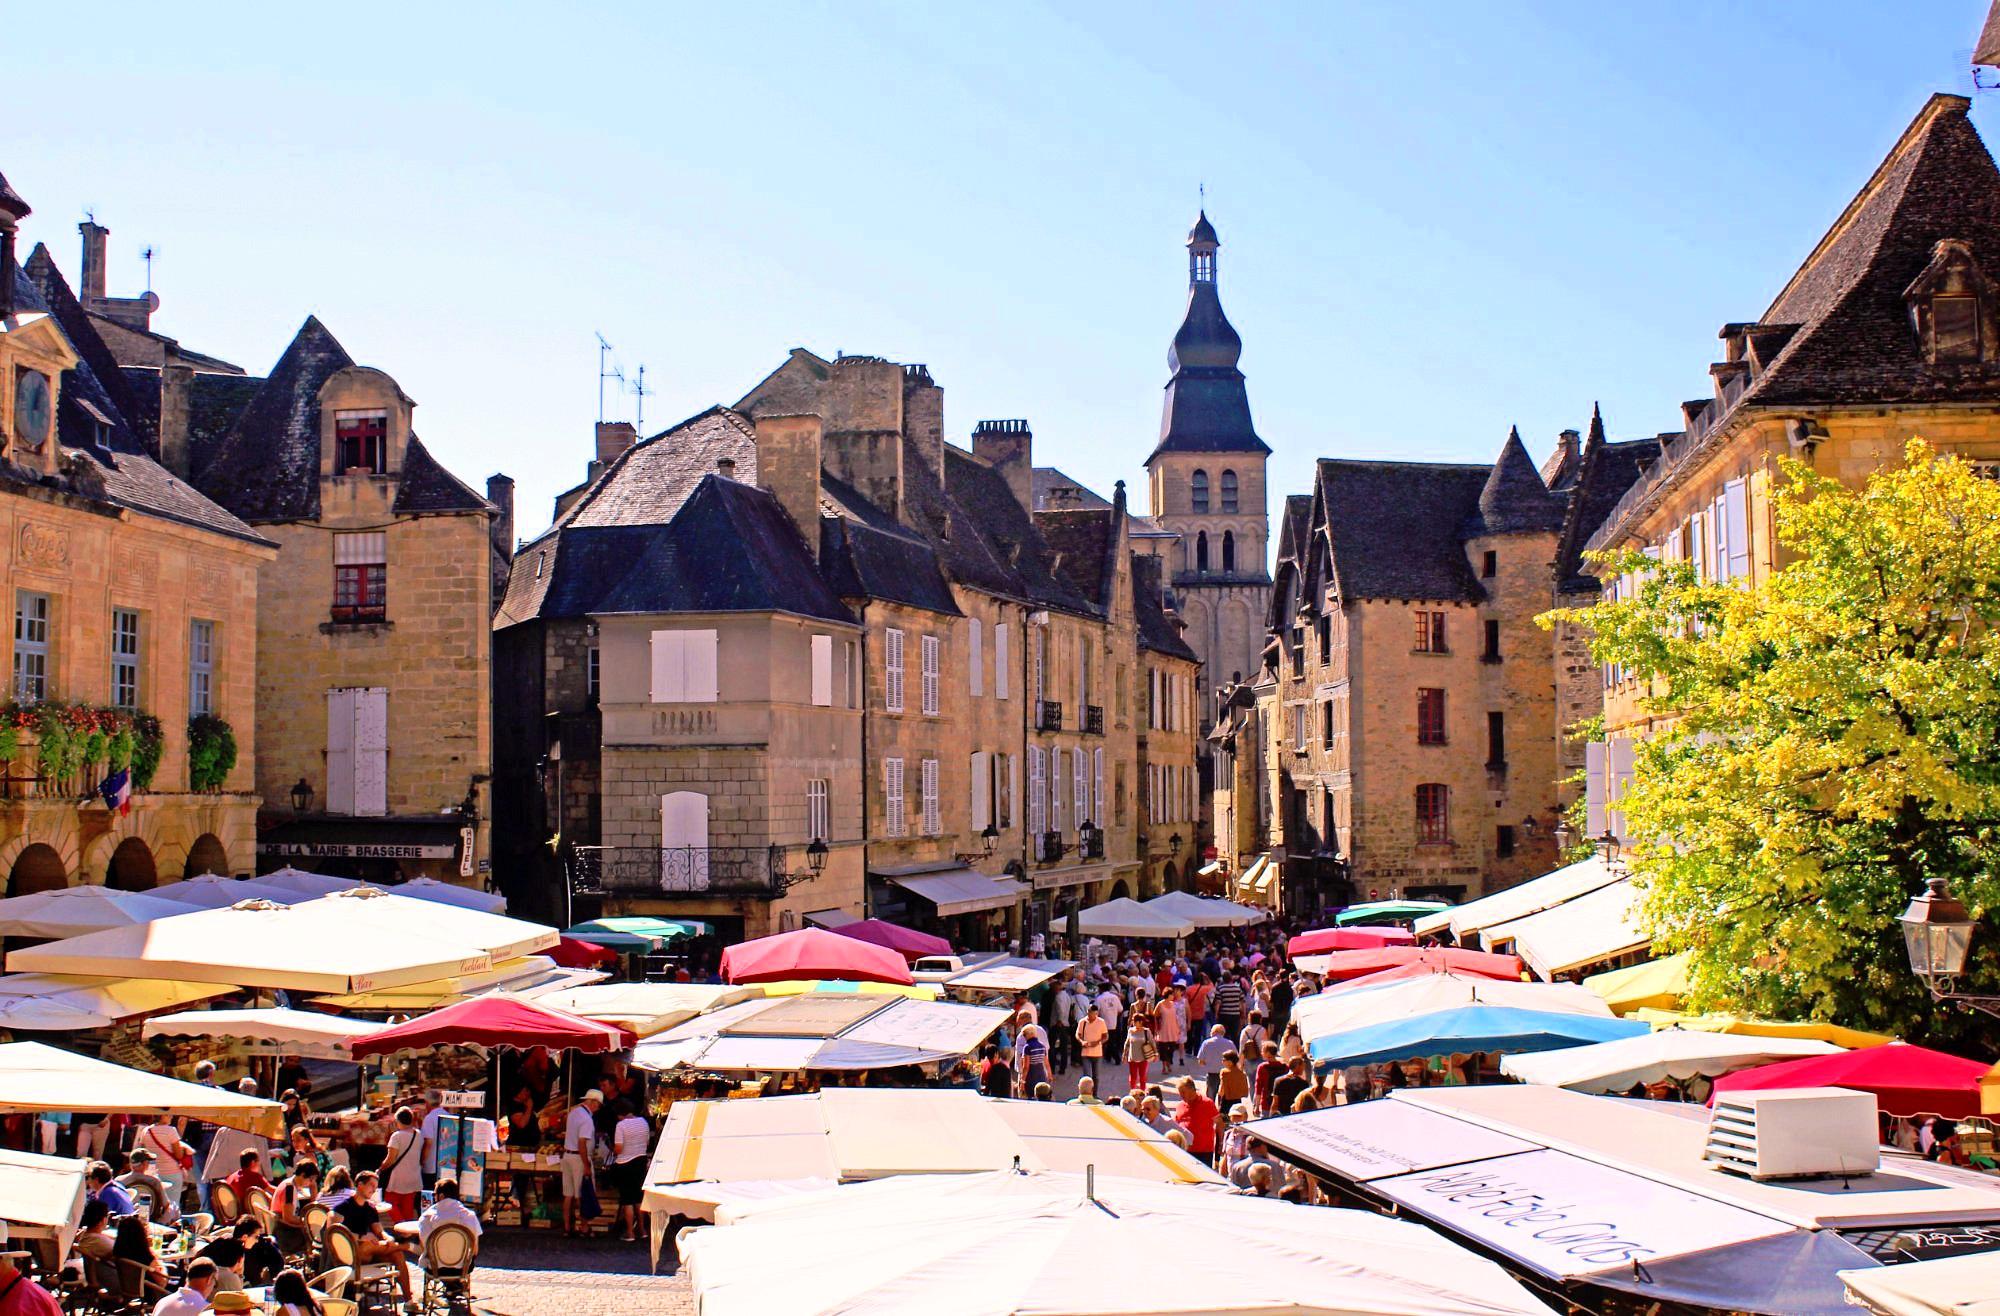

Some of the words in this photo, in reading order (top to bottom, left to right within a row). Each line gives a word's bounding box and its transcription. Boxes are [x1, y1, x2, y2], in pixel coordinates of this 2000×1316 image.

[265, 845, 281, 855] DE
[287, 845, 303, 856] LA
[356, 846, 422, 857] BRASSERIE
[463, 829, 472, 871] HOTEL
[1468, 1194, 1576, 1227] Foie
[1532, 1222, 1656, 1263] Gras
